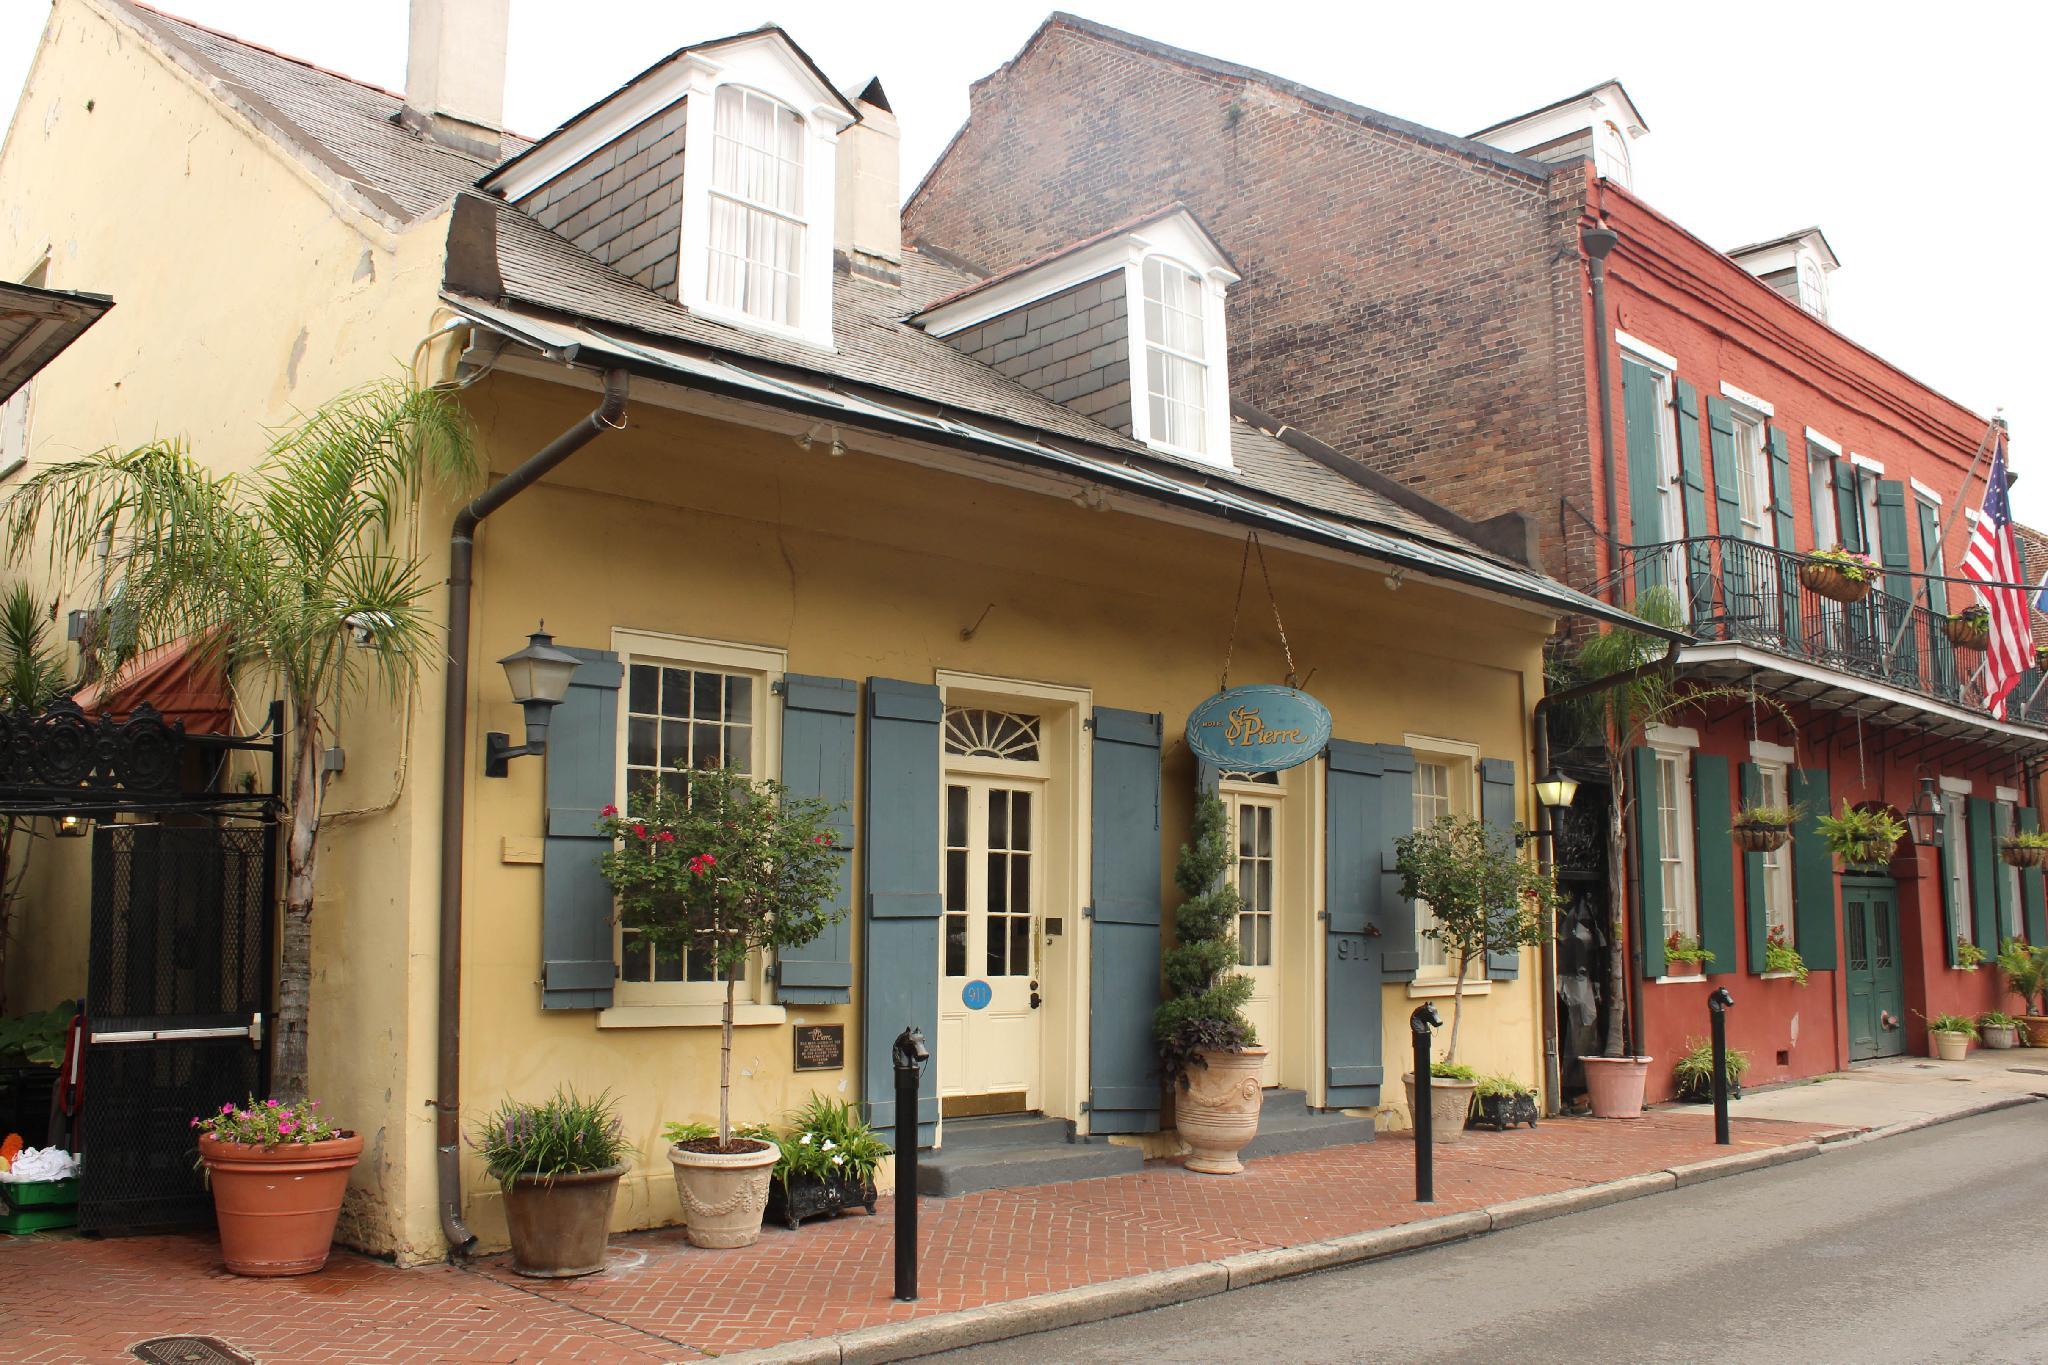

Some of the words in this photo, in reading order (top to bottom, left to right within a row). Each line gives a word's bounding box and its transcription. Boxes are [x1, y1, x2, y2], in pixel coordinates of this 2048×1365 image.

[1225, 704, 1260, 746] St
[1240, 715, 1309, 746] Pierre
[1337, 939, 1369, 961] 911
